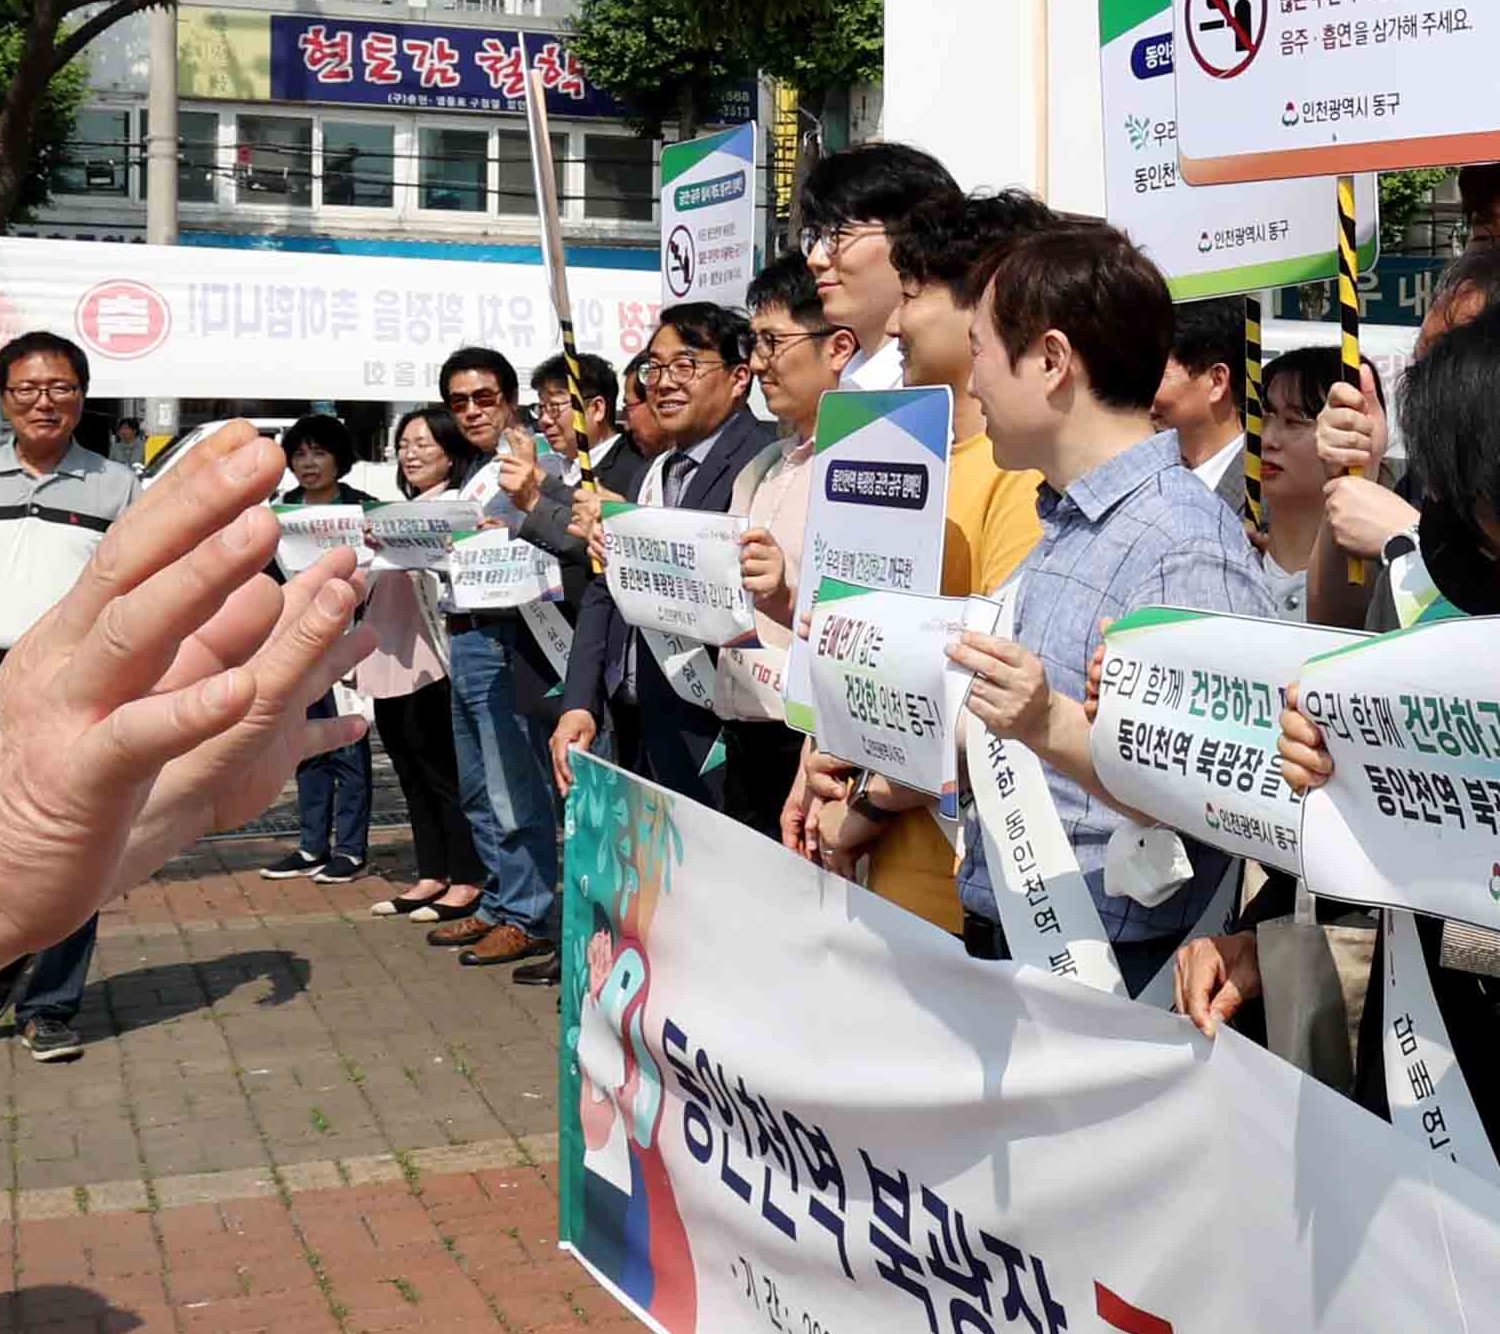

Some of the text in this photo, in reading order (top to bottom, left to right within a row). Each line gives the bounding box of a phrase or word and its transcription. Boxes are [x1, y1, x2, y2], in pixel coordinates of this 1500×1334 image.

[1280, 7, 1474, 57] 음주 흡연을 삼가해 주세요.
[1302, 91, 1401, 125] 인천광역시 동구
[1214, 219, 1289, 250] 인천광역시 동구
[1101, 658, 1274, 730] 우리 함께 건강하고
[1307, 691, 1352, 744] 우리
[1352, 693, 1398, 750] 함께
[1116, 717, 1193, 778] 동인천역
[1364, 765, 1465, 830] 동인천역
[1218, 807, 1297, 855] 인천광역시 동구
[1004, 808, 1063, 936] 동인천역
[663, 1017, 855, 1281] 동인천역
